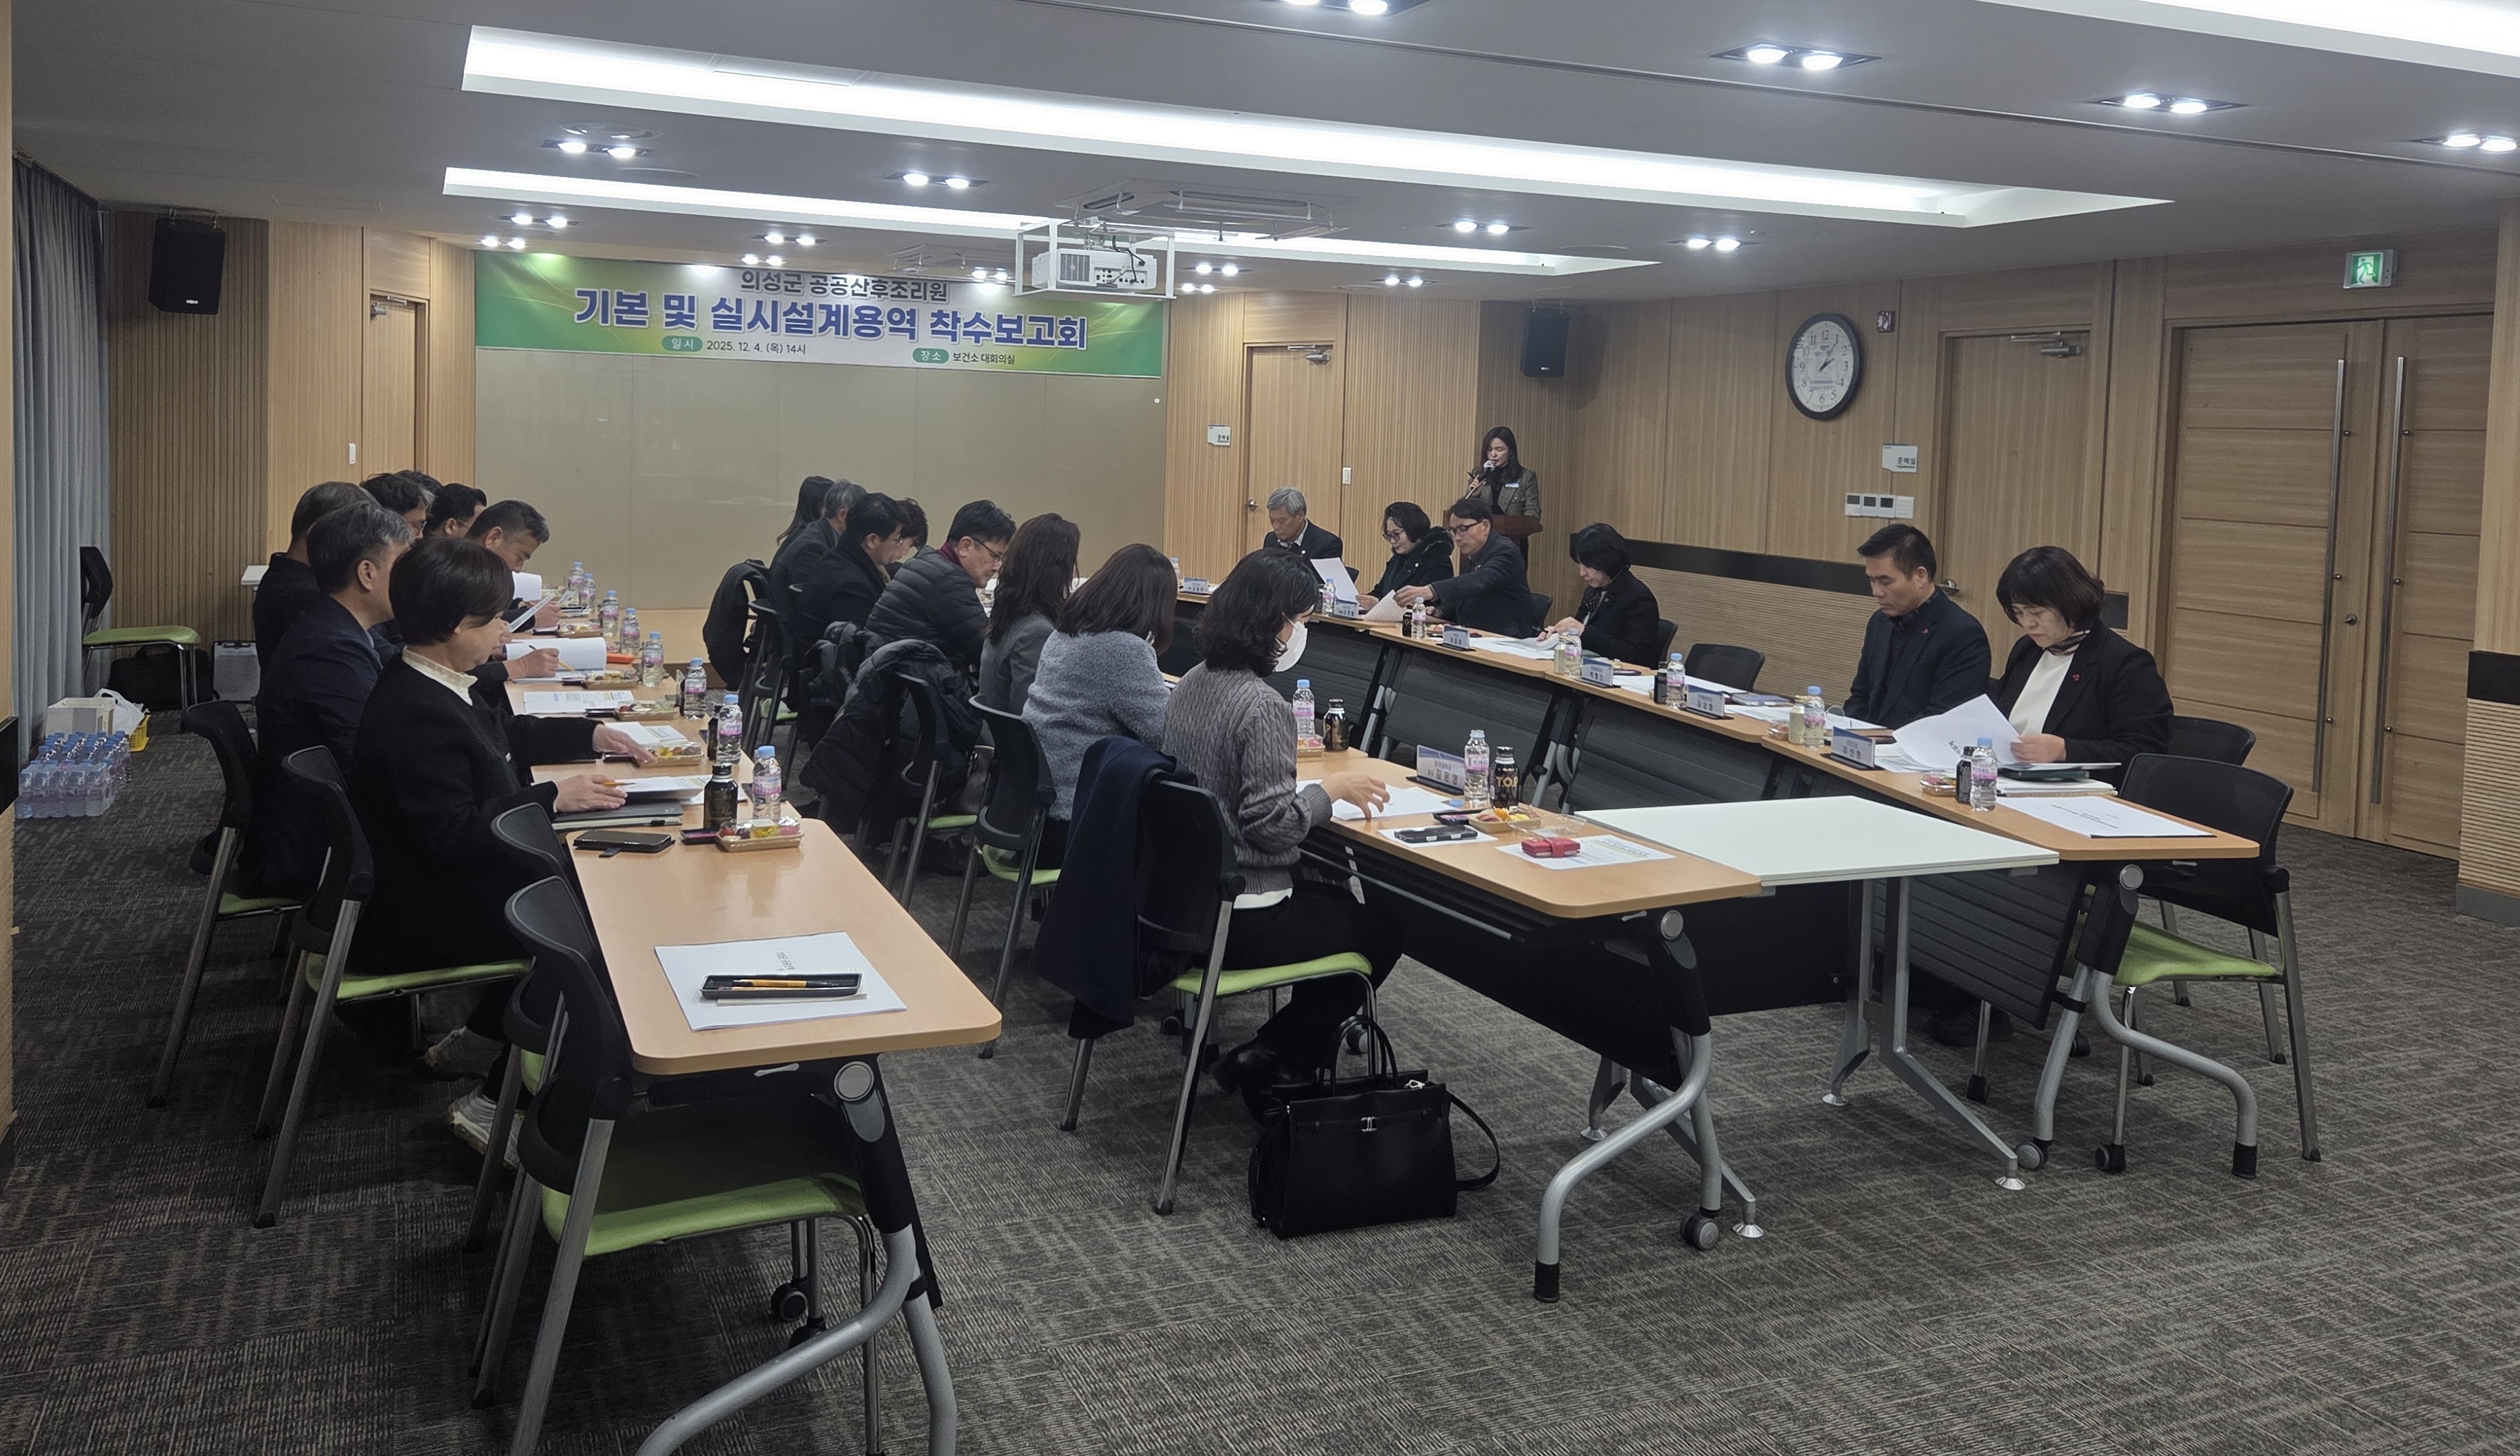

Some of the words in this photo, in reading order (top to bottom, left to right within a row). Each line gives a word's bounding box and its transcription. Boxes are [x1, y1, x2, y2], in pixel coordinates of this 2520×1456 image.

[741, 270, 802, 293] 의성군
[810, 275, 947, 302] 공공산후조리원
[576, 290, 649, 326] 기본
[664, 294, 696, 329] 및
[711, 297, 916, 341] 실시설계용역
[930, 309, 1085, 348] 착수보고회
[1810, 335, 1816, 345] 11
[1822, 330, 1829, 340] 12
[707, 341, 735, 351] 2025.
[754, 343, 762, 353] 4.
[766, 343, 783, 354] (목)
[786, 344, 806, 355] 14시
[1842, 345, 1847, 356] 2
[920, 350, 941, 361] 장소
[953, 353, 979, 362] 보건소
[981, 353, 1016, 365] 대회의실
[1800, 362, 1805, 372] 9
[1843, 361, 1849, 372] 3
[1801, 377, 1807, 387] 8
[1839, 377, 1844, 387] 4
[1819, 393, 1825, 403] 6
[1830, 390, 1837, 400] 5
